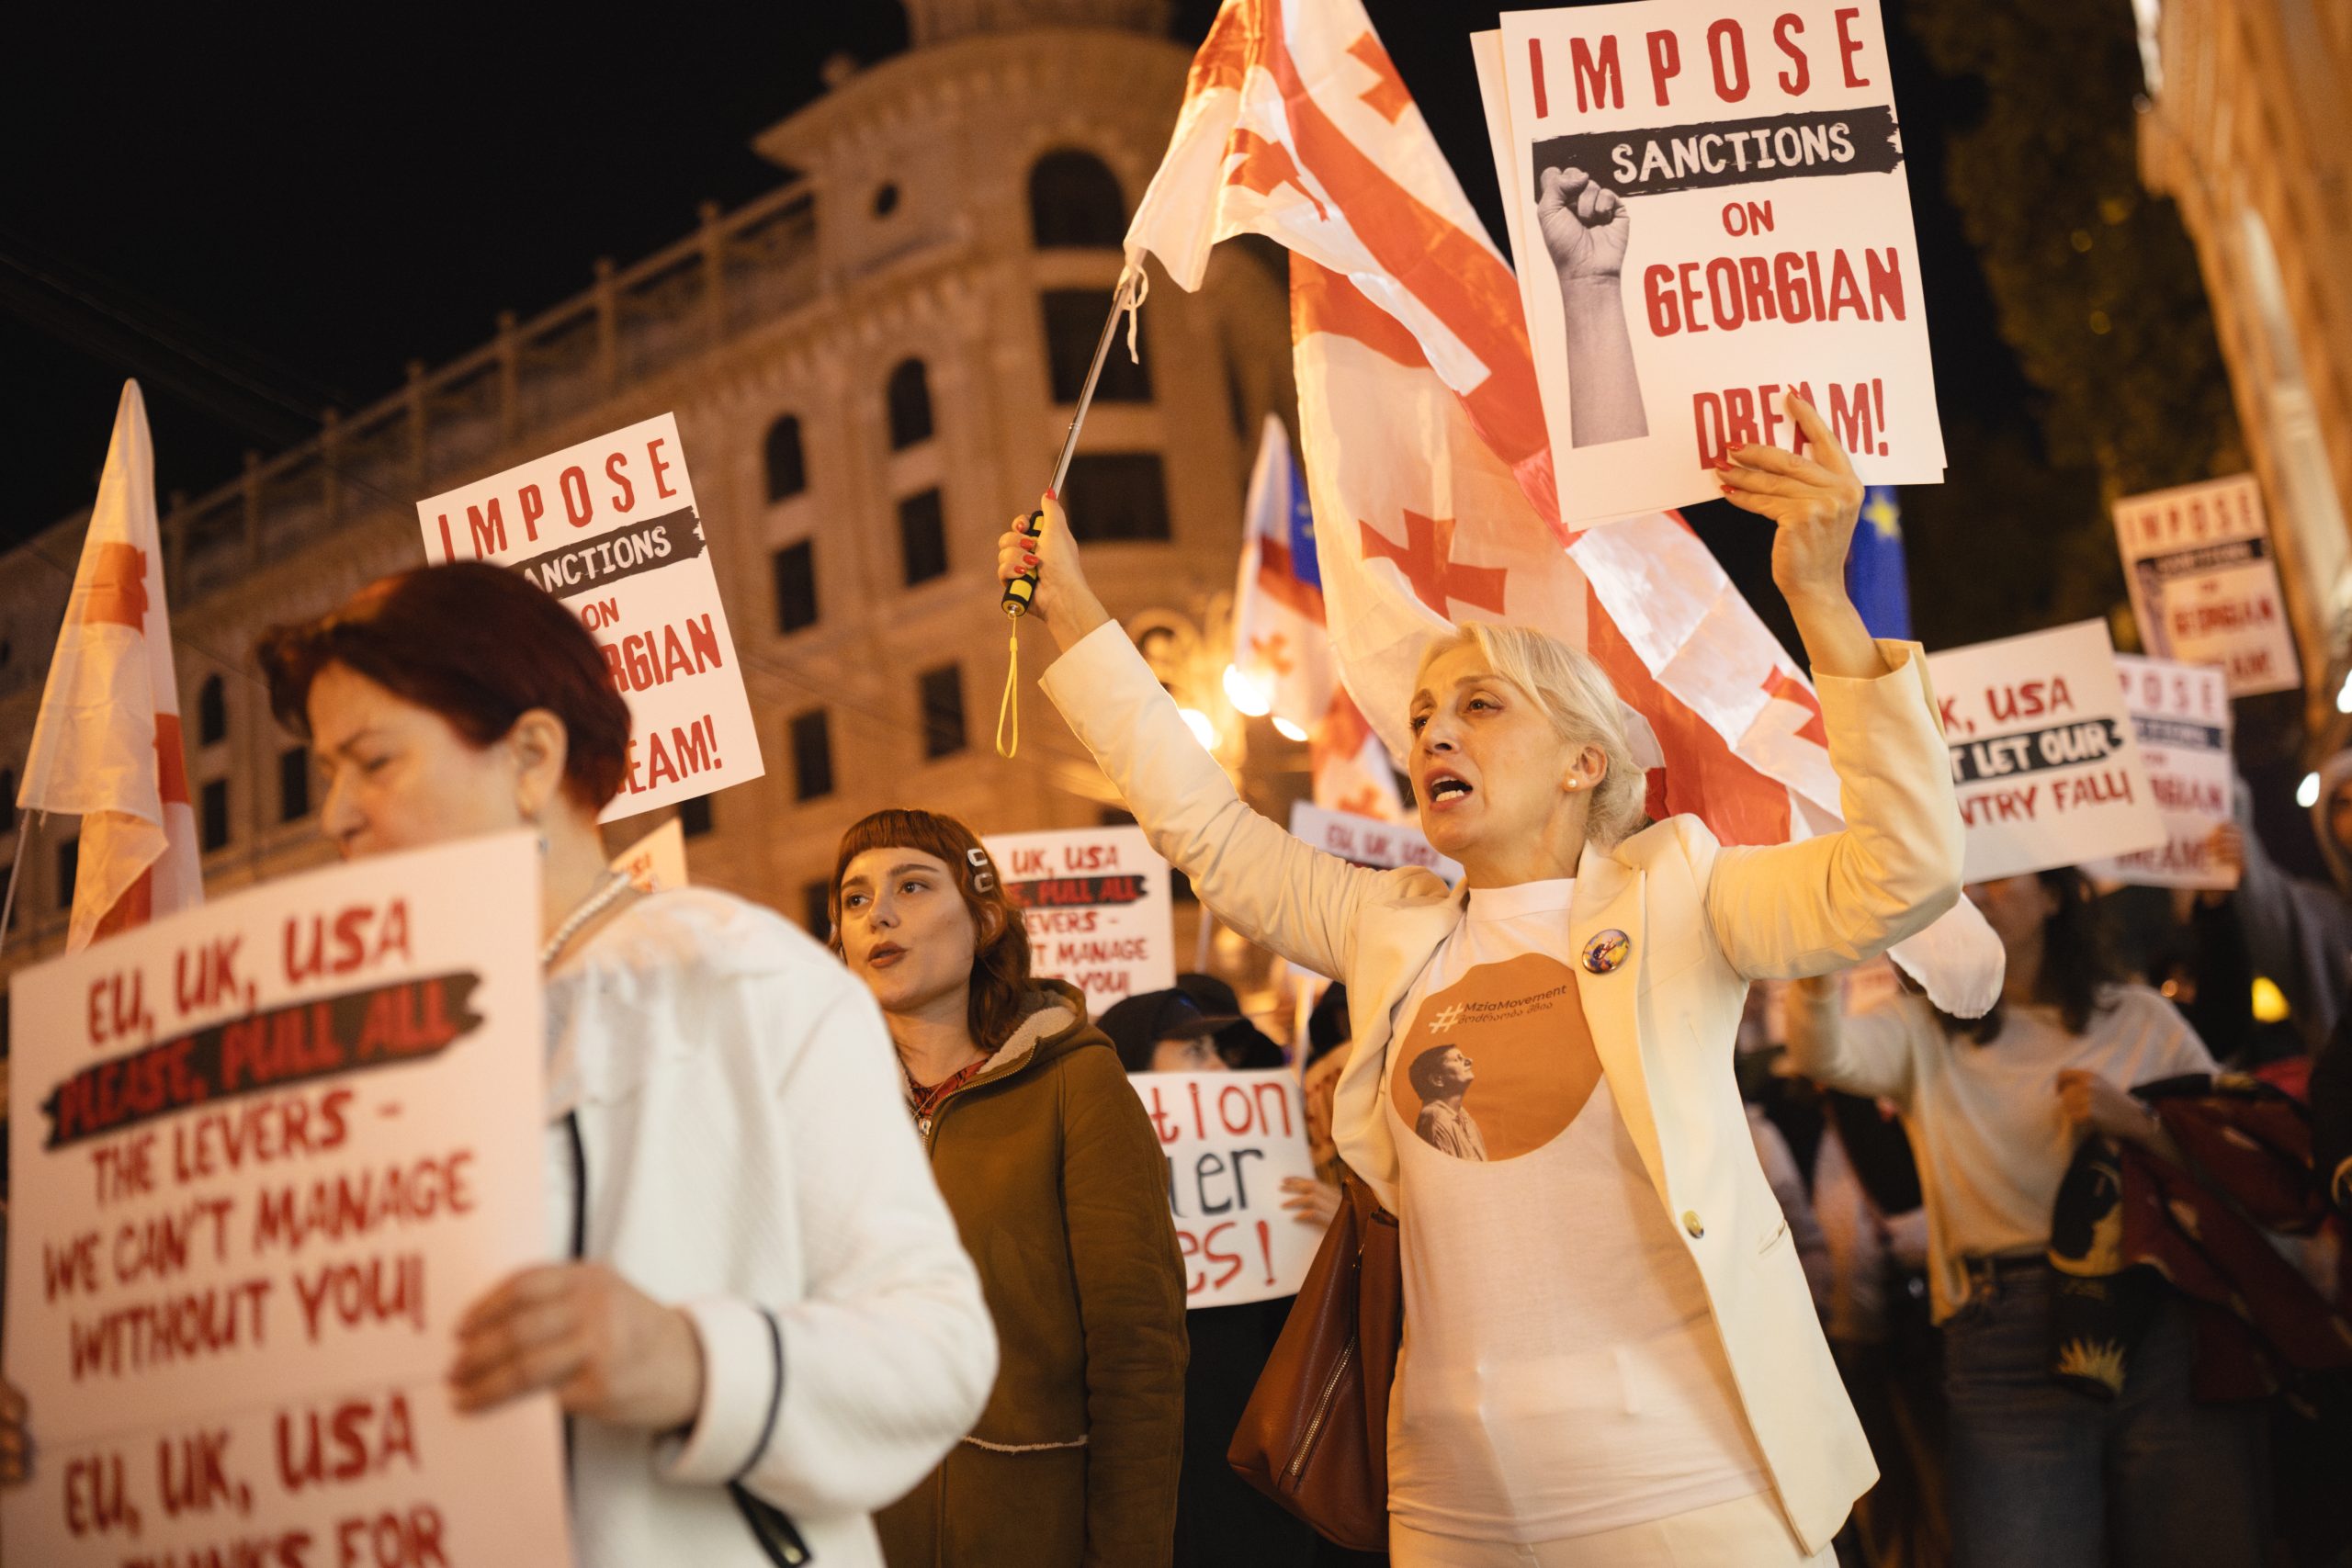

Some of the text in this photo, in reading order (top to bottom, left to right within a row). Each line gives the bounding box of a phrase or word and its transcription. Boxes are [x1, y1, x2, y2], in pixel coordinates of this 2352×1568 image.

[1529, 7, 1870, 118] IMPOSE
[1611, 123, 1855, 183] SANCTIONS
[1723, 200, 1774, 236] ON
[1644, 248, 1905, 337] GEORGIAN
[438, 438, 676, 563] IMPOSE
[525, 525, 672, 593] ANCTIONS
[582, 597, 619, 632] ON
[603, 613, 722, 693] RGIAN
[1985, 675, 2075, 722] USA
[623, 715, 722, 795] EAM!
[1972, 736, 2030, 777] LET
[2039, 723, 2109, 765] OUR
[1959, 784, 2036, 827] NTRY
[1012, 845, 1117, 878] UK, USA
[1026, 911, 1096, 933] EVERS
[1058, 938, 1147, 964] MANAGE
[85, 898, 410, 1045] EU, UK, USA
[220, 1001, 345, 1090] PULL
[357, 979, 457, 1057] ALL
[92, 1136, 156, 1209] THE
[174, 1090, 353, 1183] LEVERS
[1150, 1082, 1292, 1143] tion
[43, 1150, 475, 1303] WE CAN'T MANAGE
[70, 1280, 269, 1380] WITHOUT
[62, 1392, 421, 1540] EU, UK, USA
